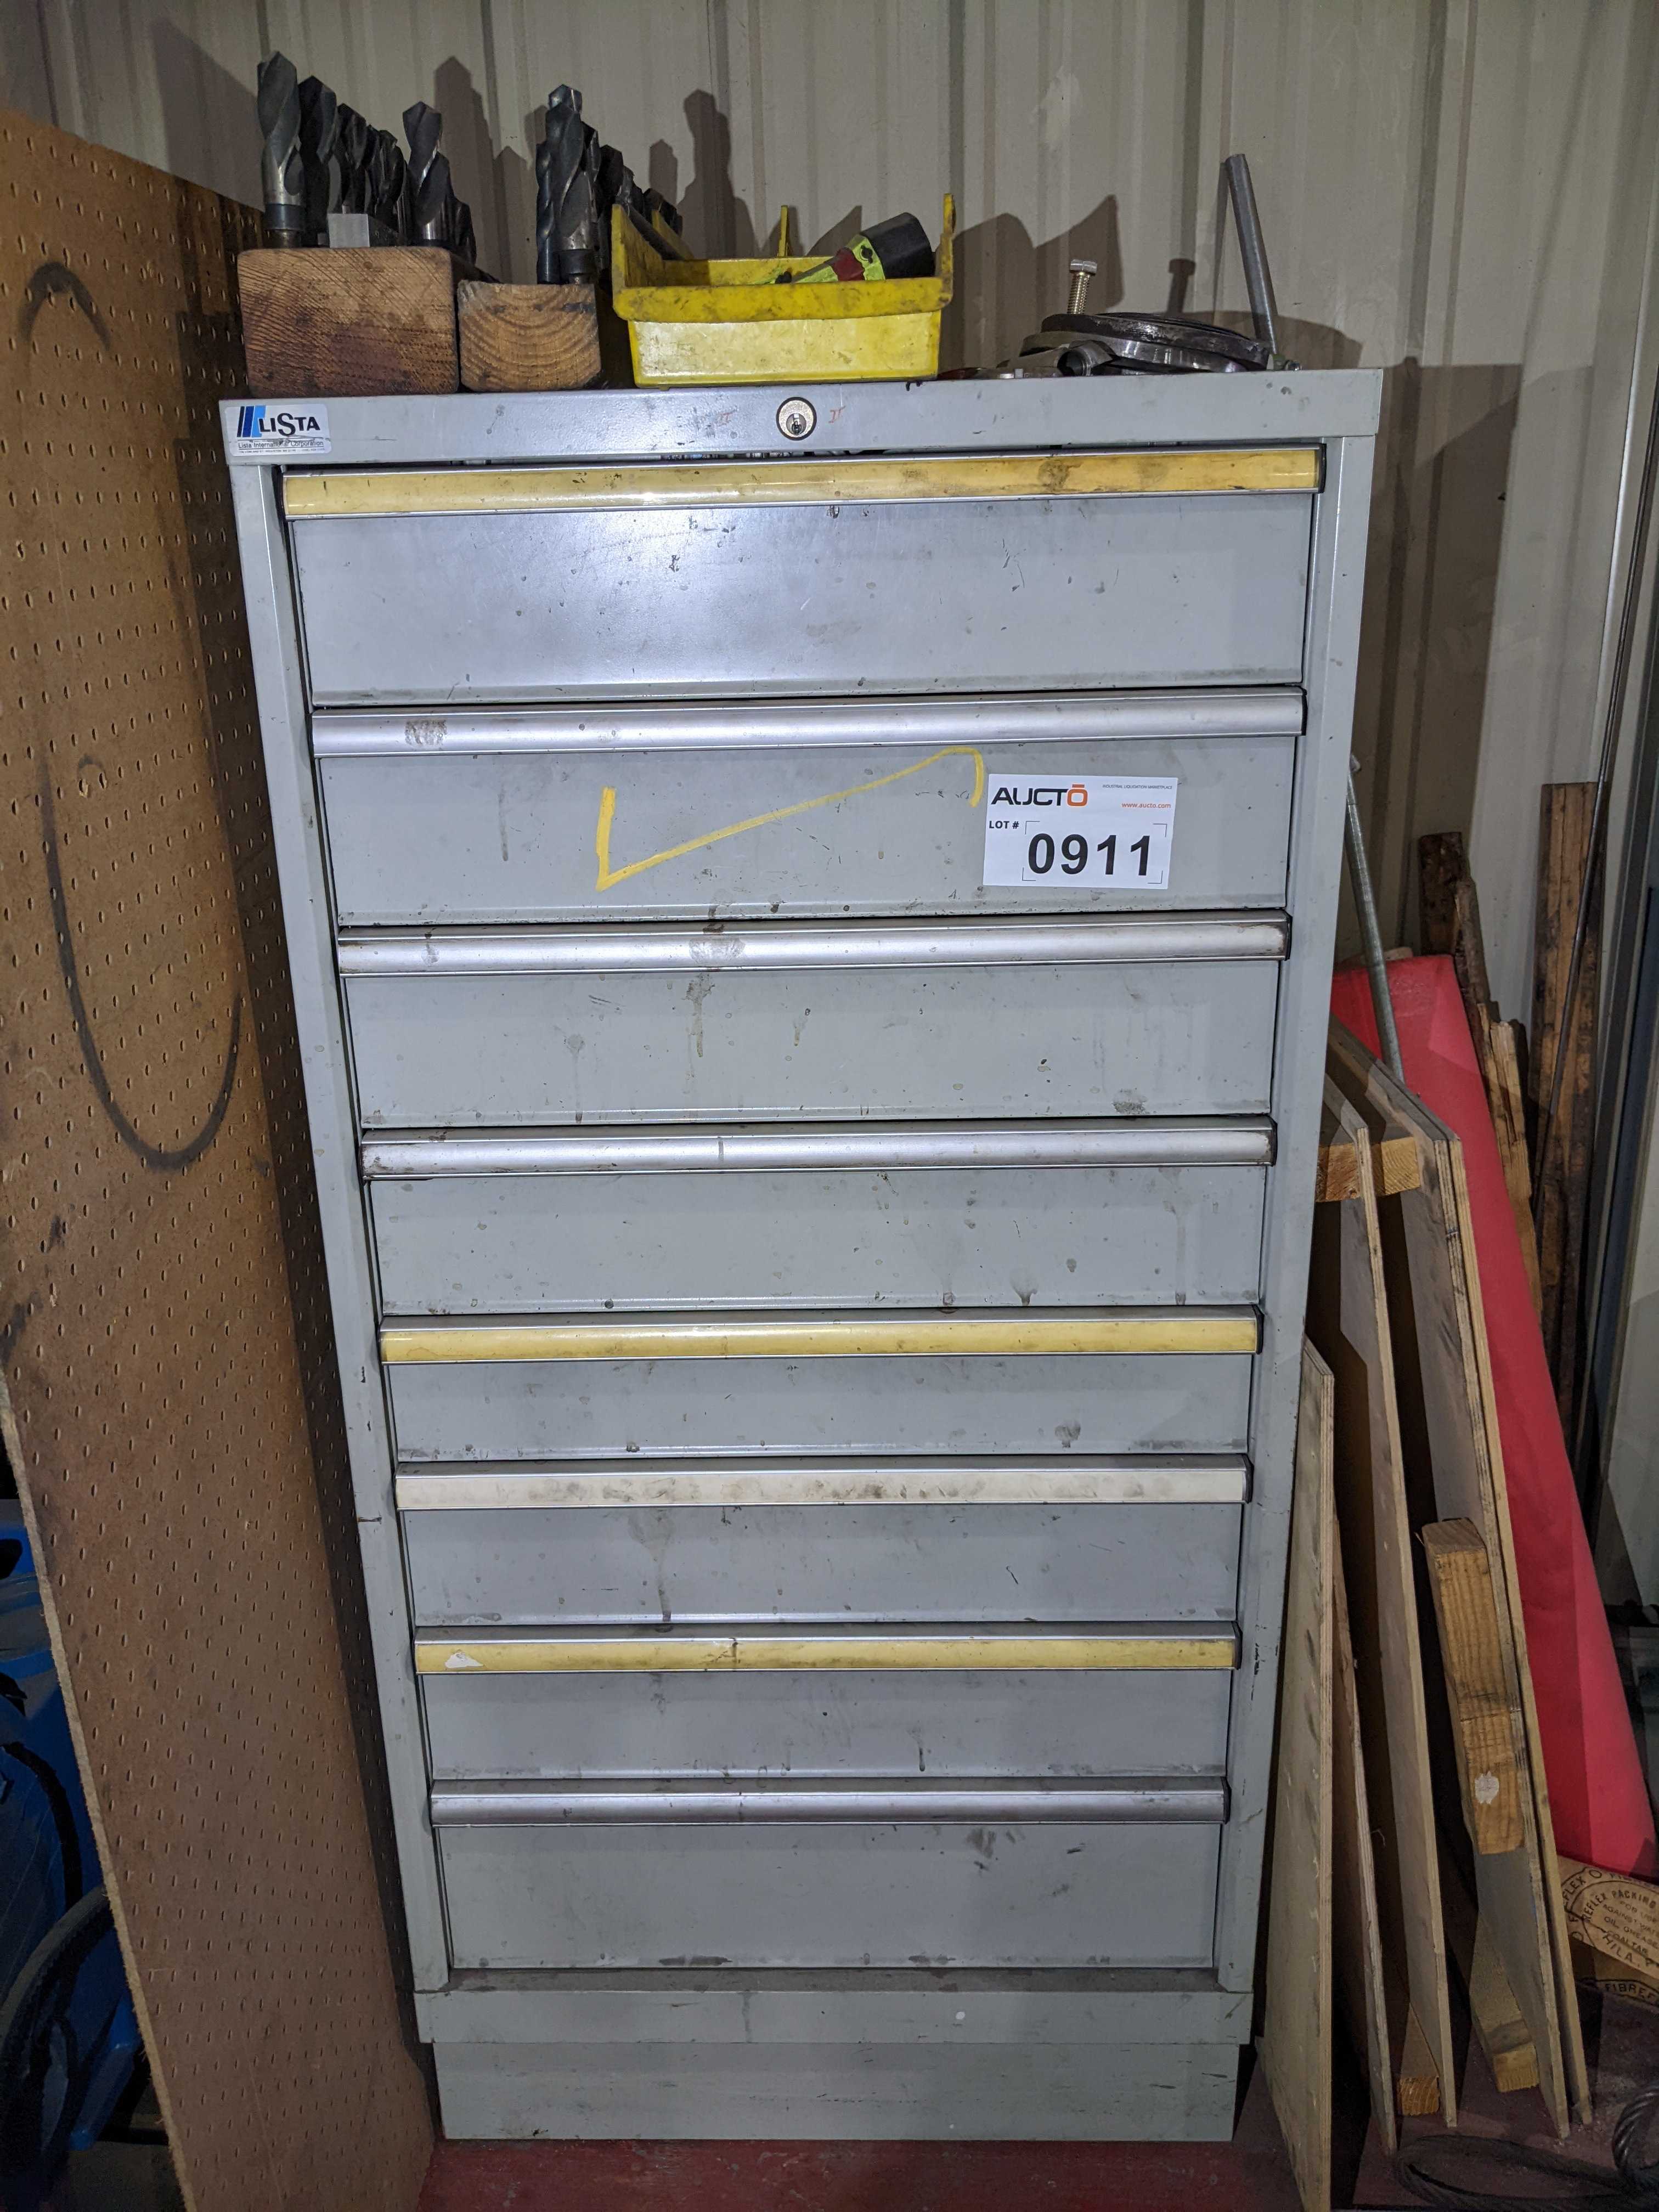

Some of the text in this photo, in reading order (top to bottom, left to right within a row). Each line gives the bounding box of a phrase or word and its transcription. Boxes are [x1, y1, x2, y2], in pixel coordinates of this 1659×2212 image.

[291, 439, 324, 448] Corporation
[989, 820, 1019, 829] LOT #
[1028, 833, 1150, 876] 0911
[1612, 1890, 1656, 1908] PACKING
[1604, 1916, 1620, 1928] OIL
